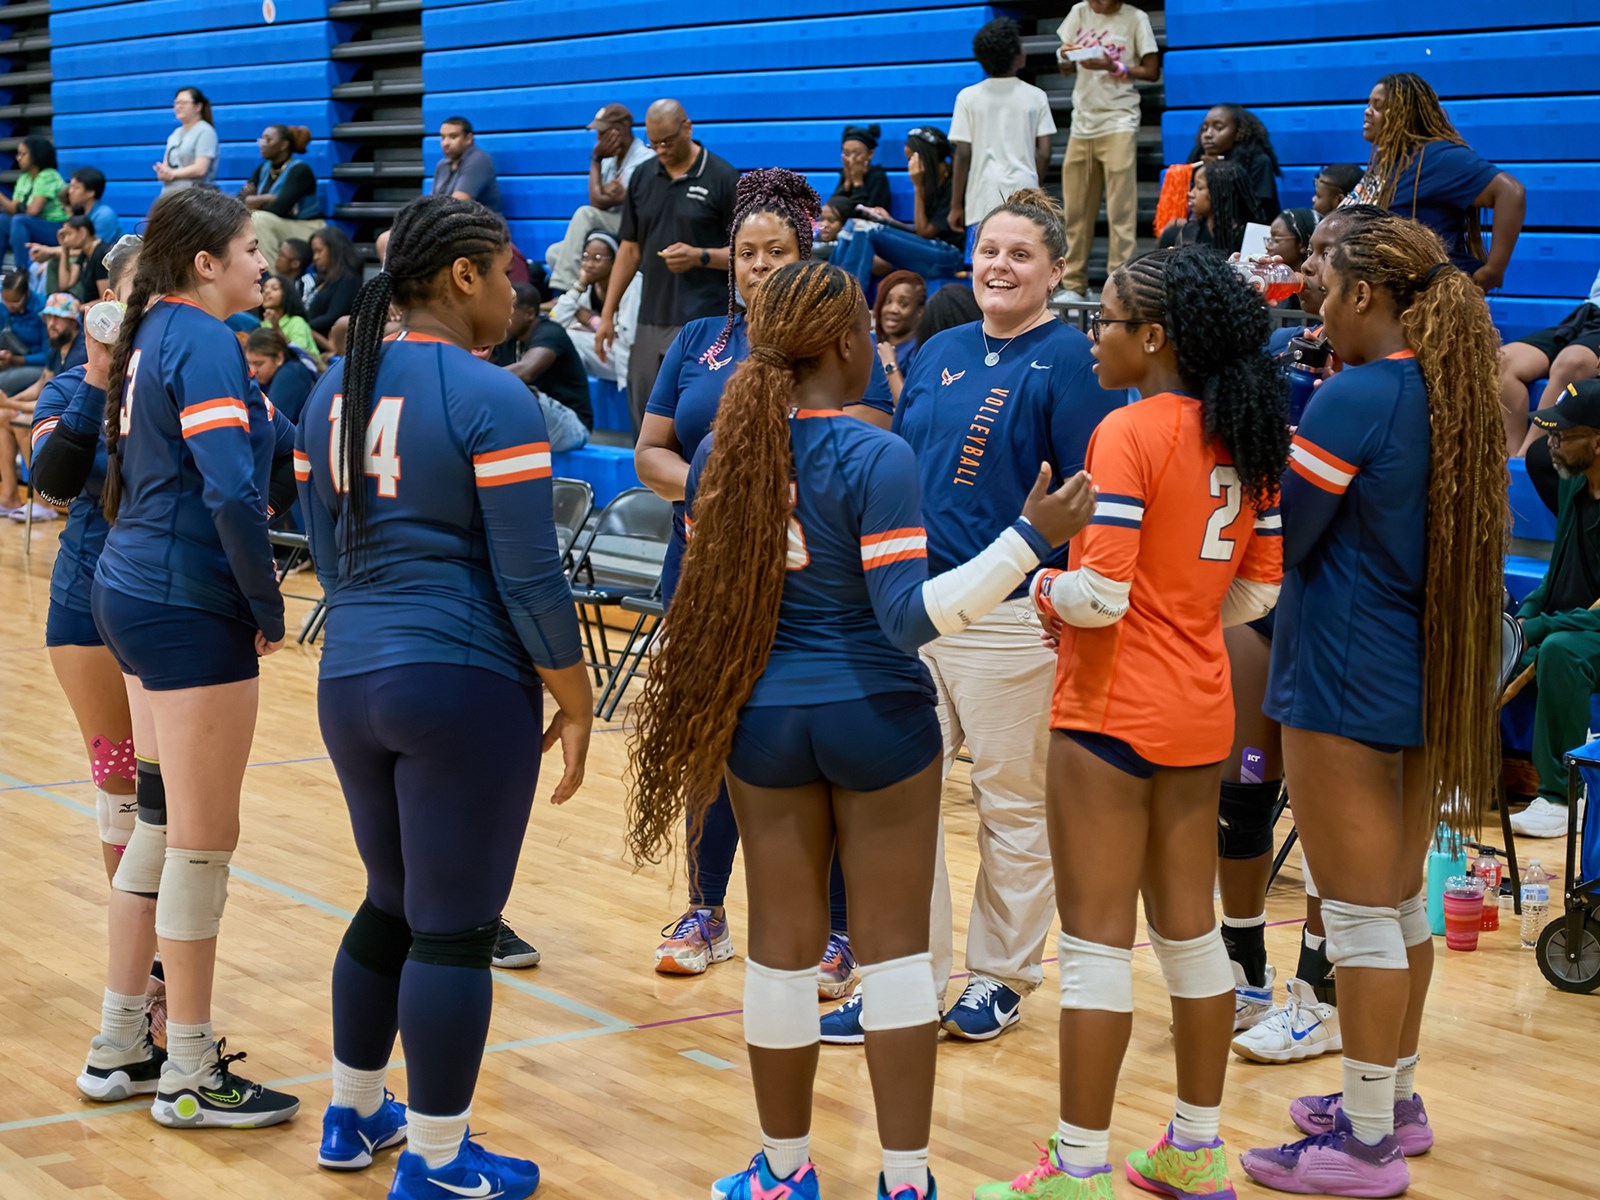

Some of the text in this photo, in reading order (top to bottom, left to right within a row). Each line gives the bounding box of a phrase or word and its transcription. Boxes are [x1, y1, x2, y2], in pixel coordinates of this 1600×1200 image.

[328, 393, 405, 499] 14
[953, 387, 1010, 486] VOLLEYBALL
[1198, 464, 1242, 562] 2
